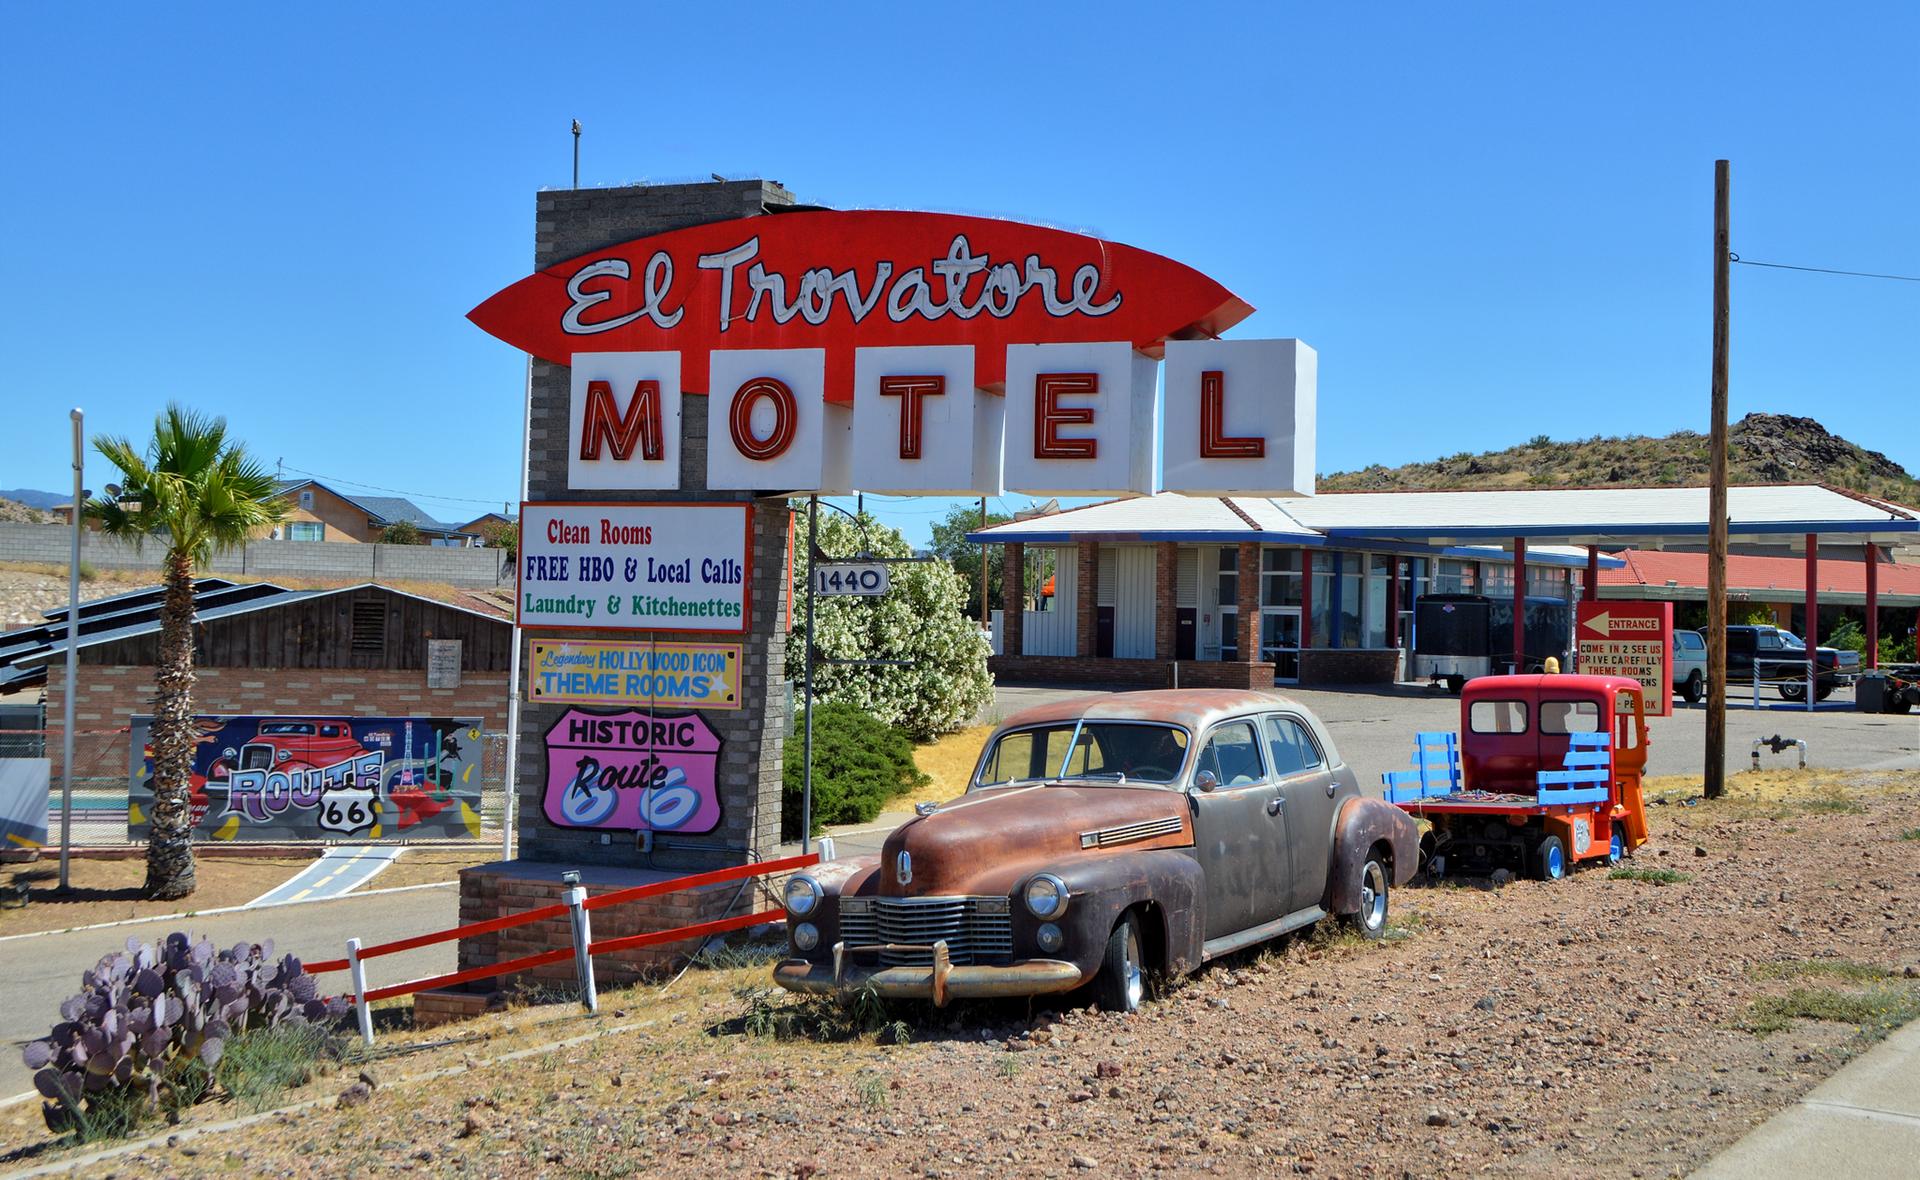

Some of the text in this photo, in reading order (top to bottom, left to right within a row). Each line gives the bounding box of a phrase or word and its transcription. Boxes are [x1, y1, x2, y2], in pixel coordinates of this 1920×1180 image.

[561, 234, 1123, 335] El Trovatore
[579, 369, 1266, 461] MOTEL
[547, 518, 652, 545] Clean Rooms
[525, 556, 742, 585] FREE HBO & Local Calls
[819, 569, 880, 592] 1440
[525, 593, 741, 618] Laundry & Kitchenettes
[1608, 620, 1657, 629] ENTRANCE
[540, 650, 726, 673] Legendary HOLLYWOOD ICON
[1579, 655, 1662, 665] DRIVE CAREFULLY
[1580, 644, 1661, 654] COME IN 2 SEE US
[1588, 666, 1652, 676] THEME ROOMS
[540, 671, 710, 698] THEME ROOMS
[1645, 700, 1656, 709] OK
[568, 719, 695, 747] HISTORIC
[218, 751, 385, 823] ROUTE
[571, 754, 669, 800] Route
[561, 765, 701, 829] 66
[326, 800, 366, 825] 66
